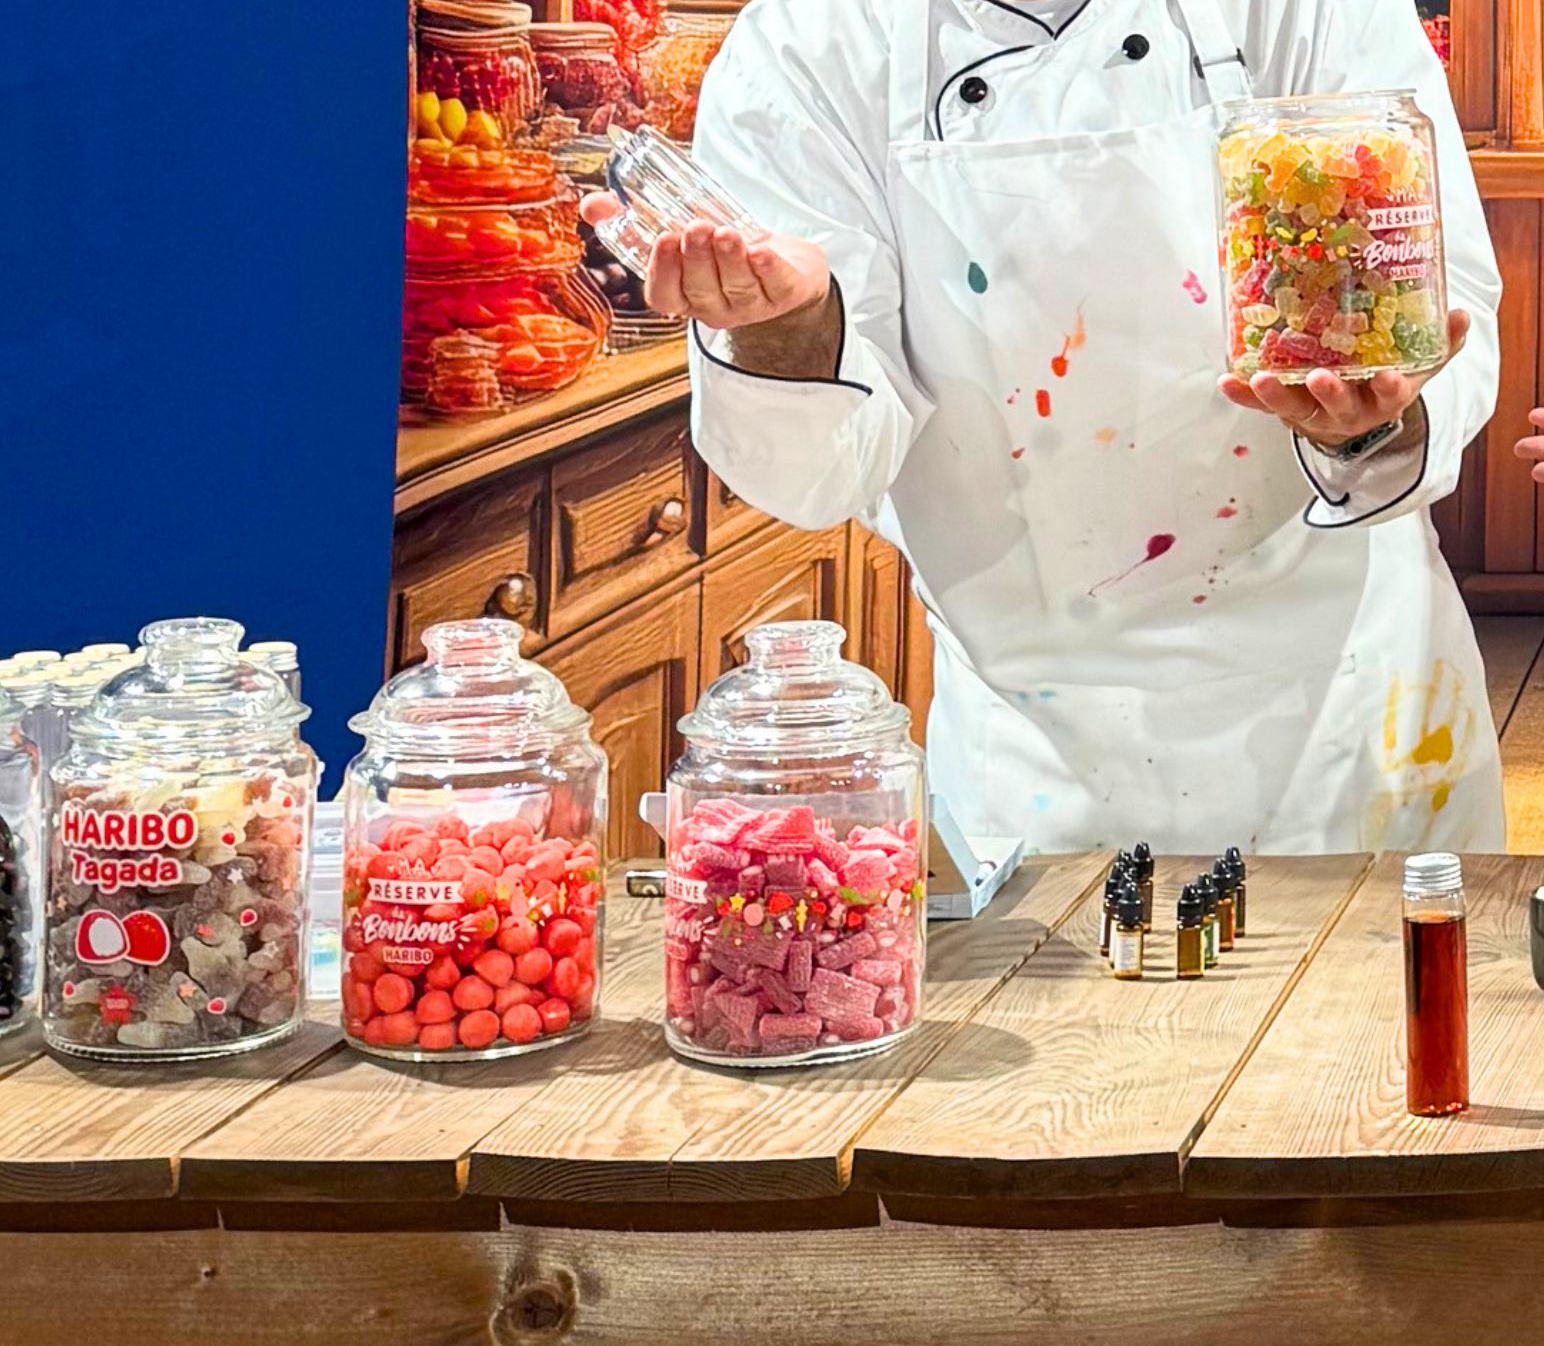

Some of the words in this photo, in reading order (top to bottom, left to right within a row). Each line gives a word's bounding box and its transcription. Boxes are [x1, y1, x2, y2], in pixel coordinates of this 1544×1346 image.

[62, 804, 197, 849] HARIBO
[70, 850, 181, 892] Tagada
[373, 882, 453, 901] RÉSERVE
[362, 913, 458, 944] Bonbons
[382, 945, 434, 964] HARIBO
